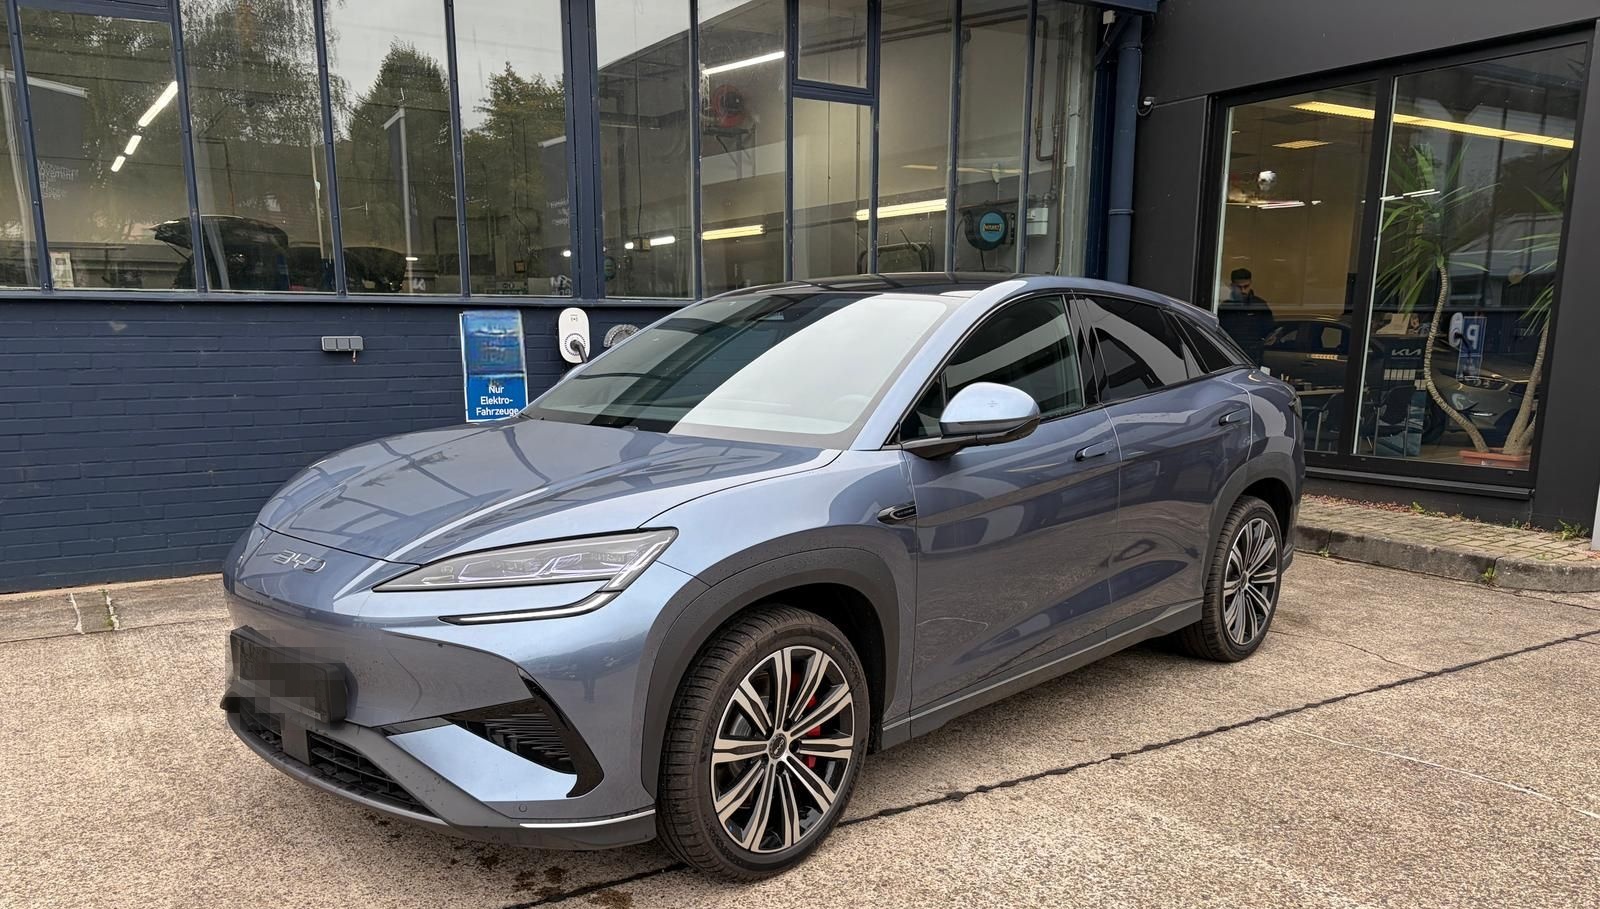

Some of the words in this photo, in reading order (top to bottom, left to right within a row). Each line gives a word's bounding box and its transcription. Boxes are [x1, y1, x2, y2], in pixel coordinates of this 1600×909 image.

[489, 386, 504, 394] Nur
[480, 396, 513, 405] Elektro-
[476, 407, 519, 417] Fahrzeuge
[273, 549, 326, 573] BYD
